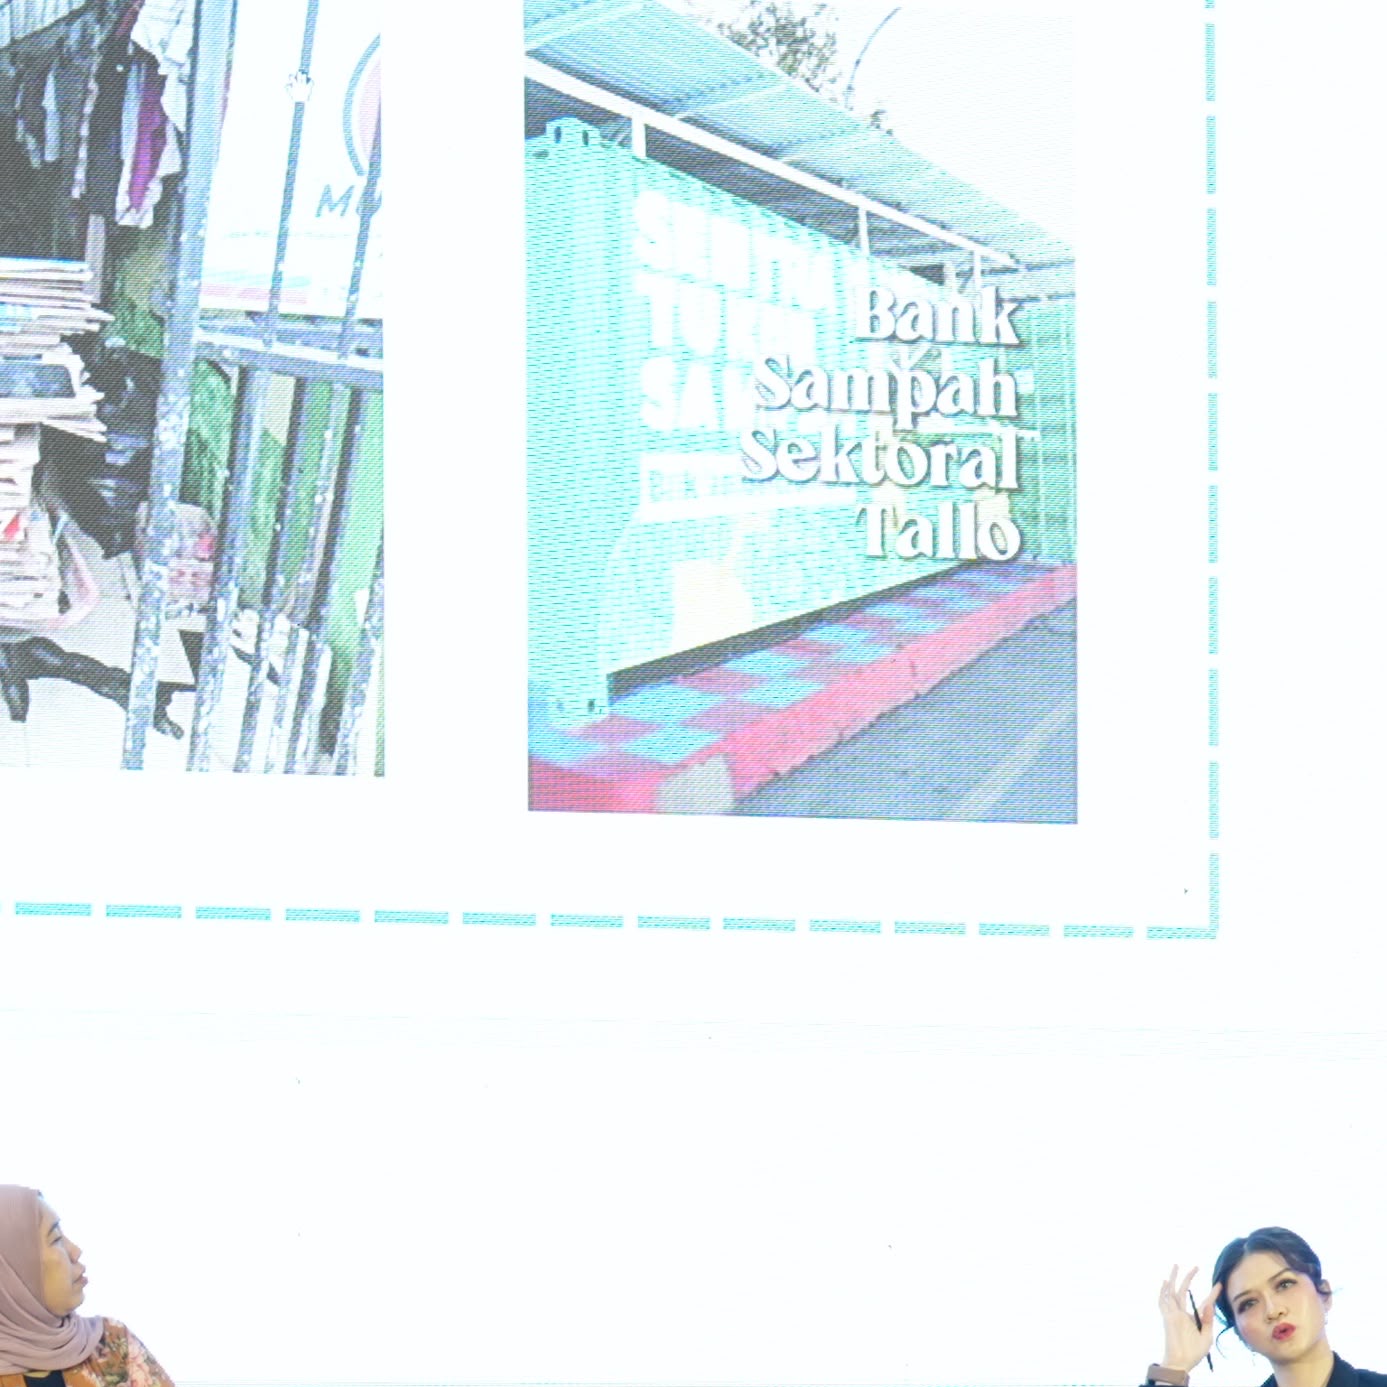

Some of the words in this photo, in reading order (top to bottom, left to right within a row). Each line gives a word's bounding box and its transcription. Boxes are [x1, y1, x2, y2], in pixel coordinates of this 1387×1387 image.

[855, 286, 1022, 346] Bank
[754, 355, 1019, 432] Sampah
[740, 424, 1021, 490] Sektoral
[856, 501, 1023, 562] Tallo
